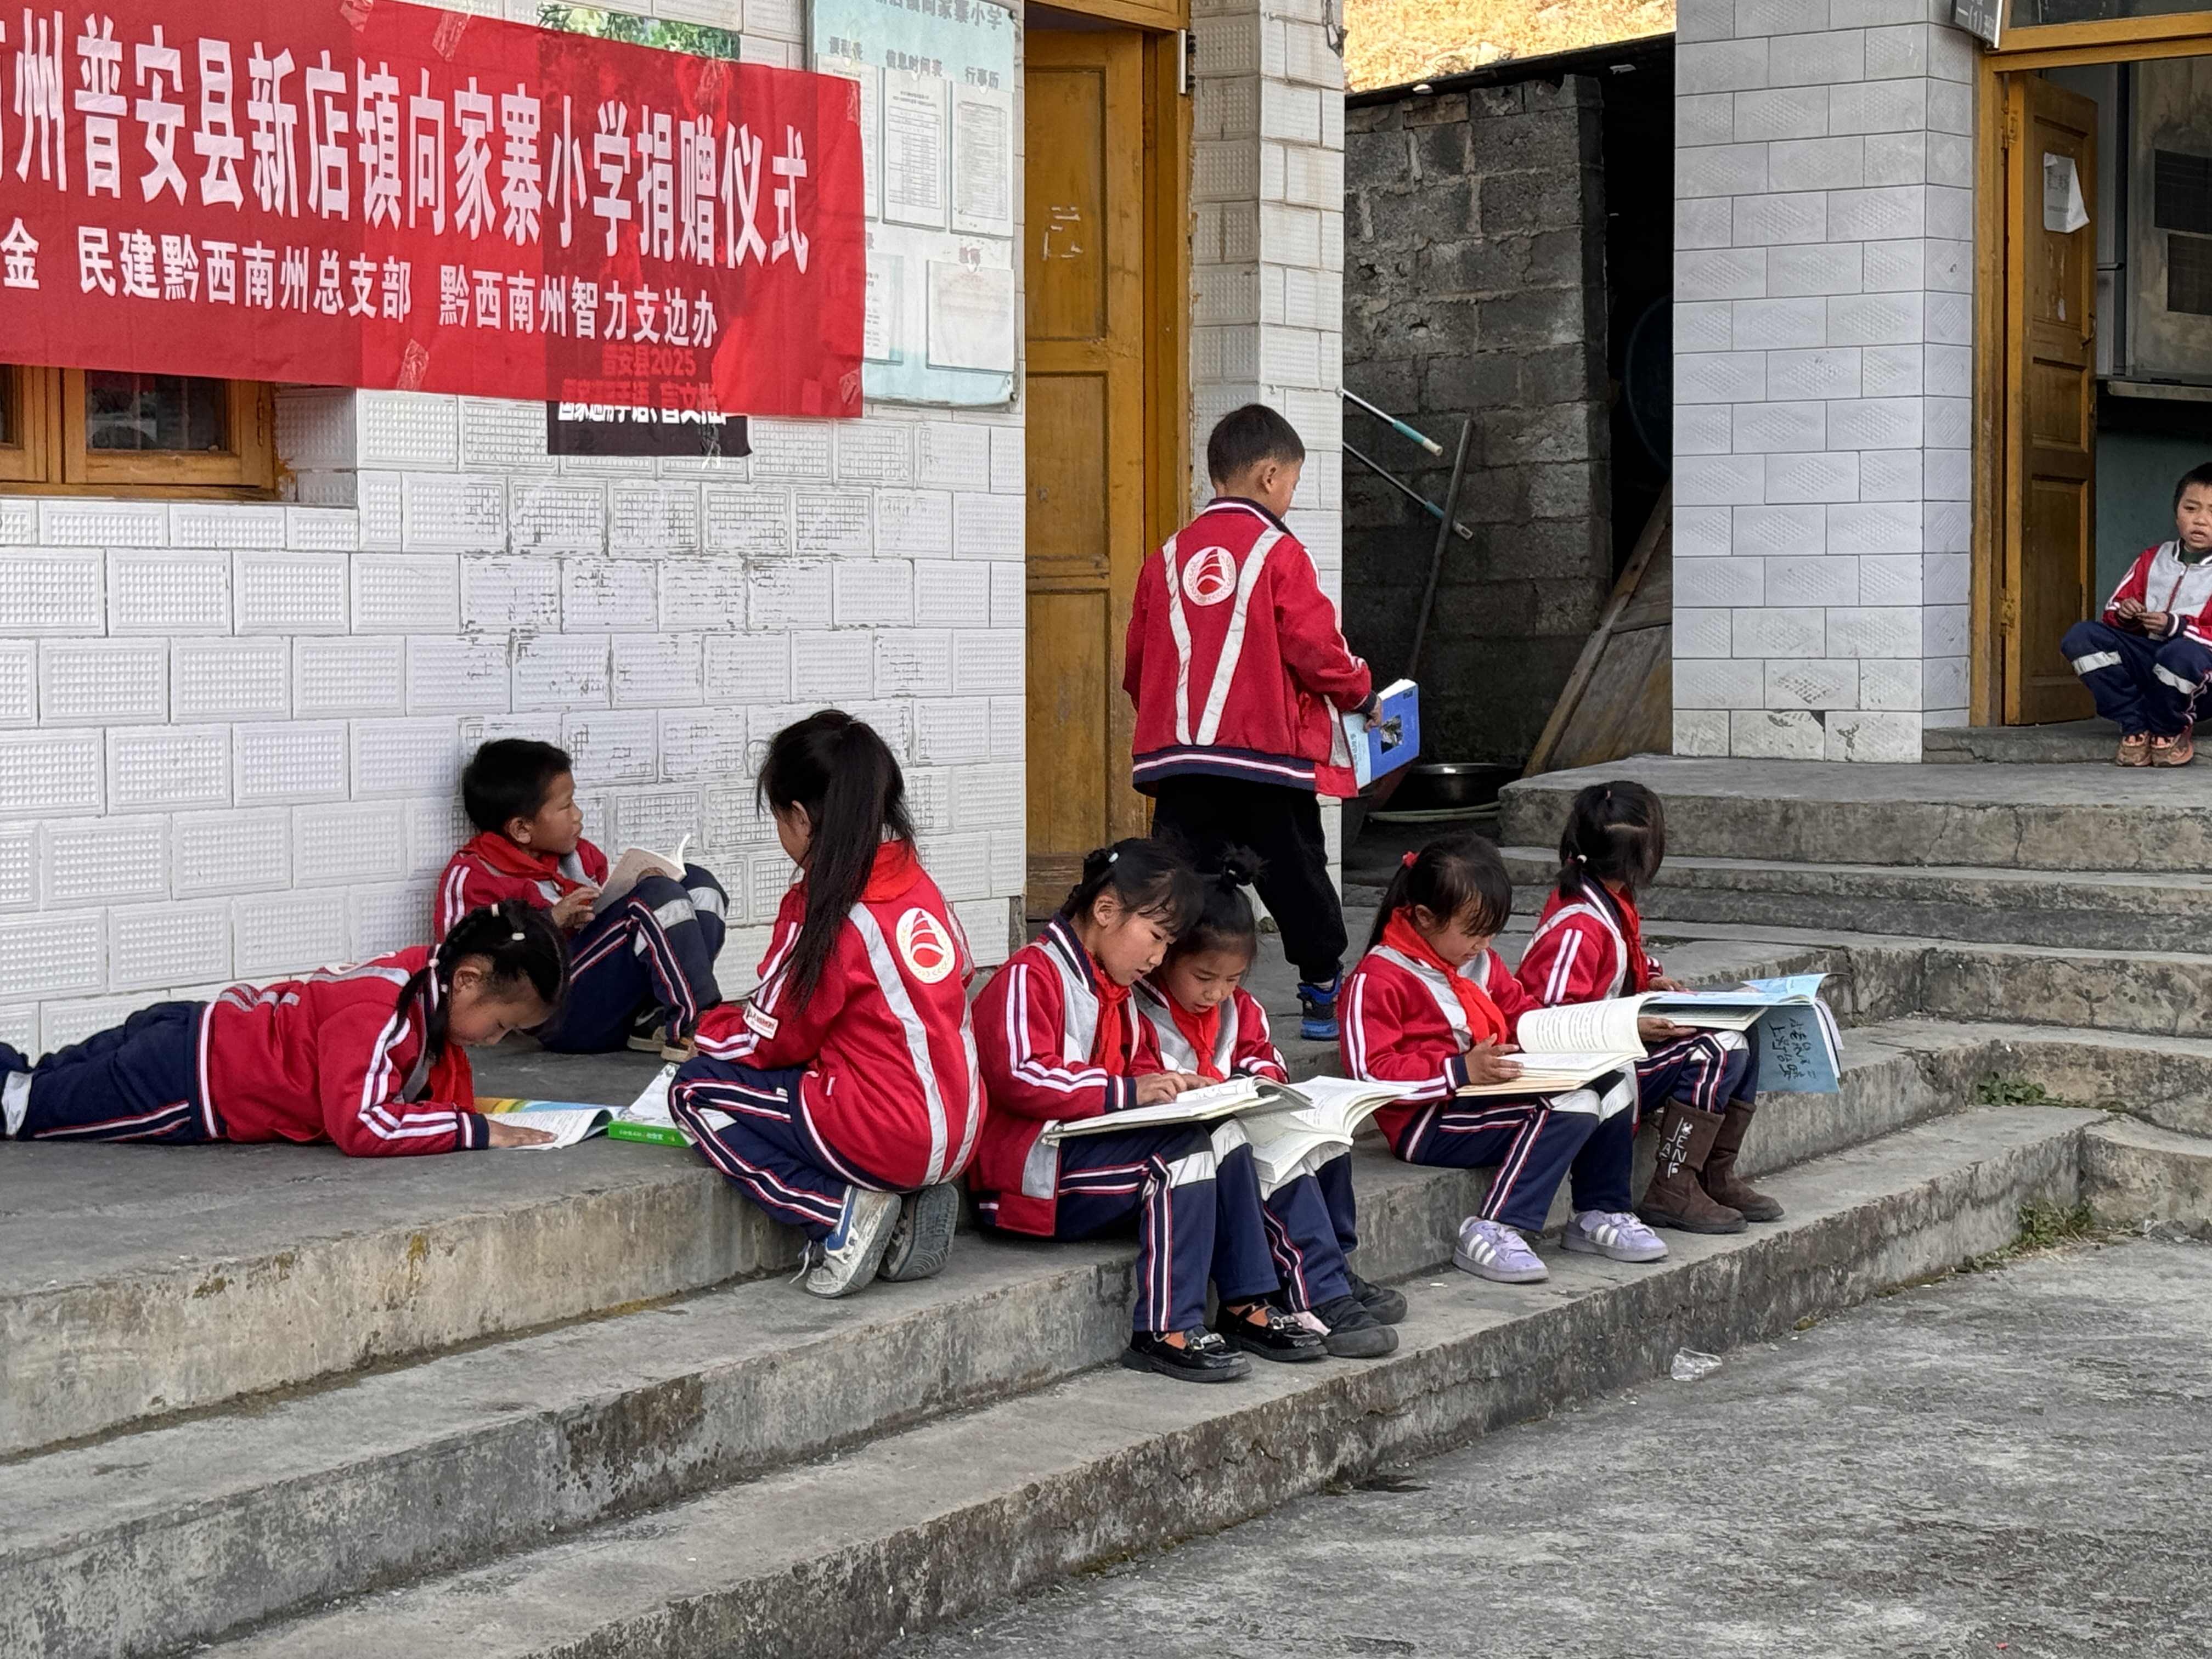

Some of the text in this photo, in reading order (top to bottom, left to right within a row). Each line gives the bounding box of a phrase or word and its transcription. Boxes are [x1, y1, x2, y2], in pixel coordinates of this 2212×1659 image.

[0, 8, 809, 275] 州普安县新店镇向家寨小学捐赠仪式
[0, 218, 718, 348] 金 民建黔西南州总支部 黔西南州智力支边办
